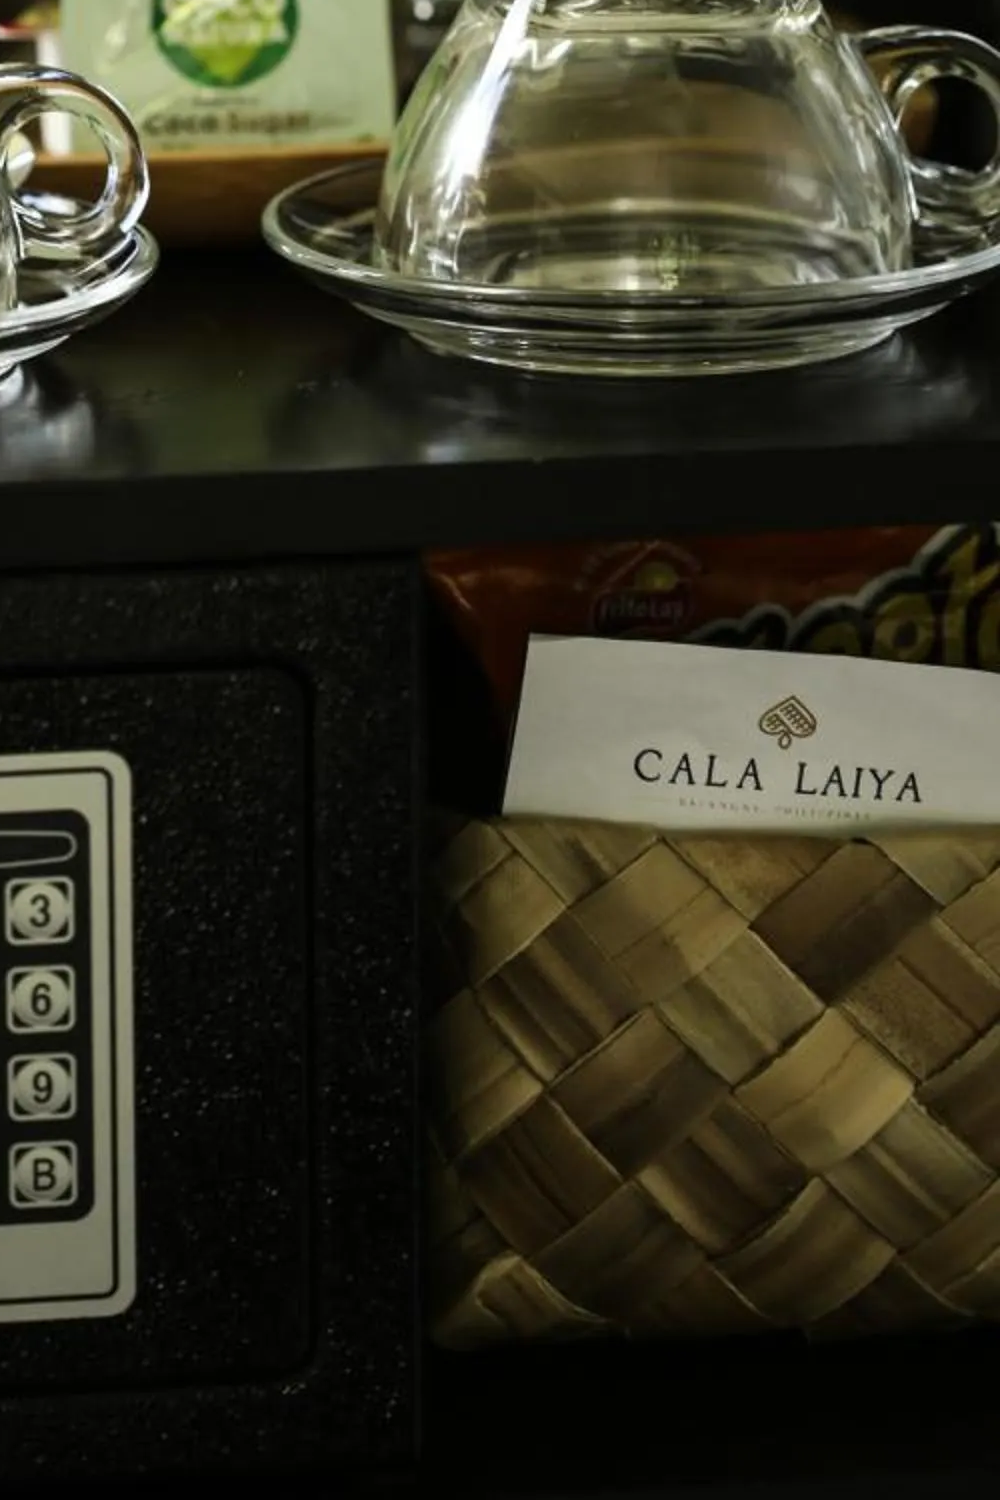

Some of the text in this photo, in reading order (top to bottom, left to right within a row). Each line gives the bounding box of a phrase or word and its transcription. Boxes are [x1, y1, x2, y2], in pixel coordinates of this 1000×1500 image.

[633, 748, 923, 803] CALA LAIYA
[29, 893, 51, 928] 3
[30, 983, 52, 1016] 6
[32, 1070, 54, 1104] 9
[33, 1157, 57, 1191] B
